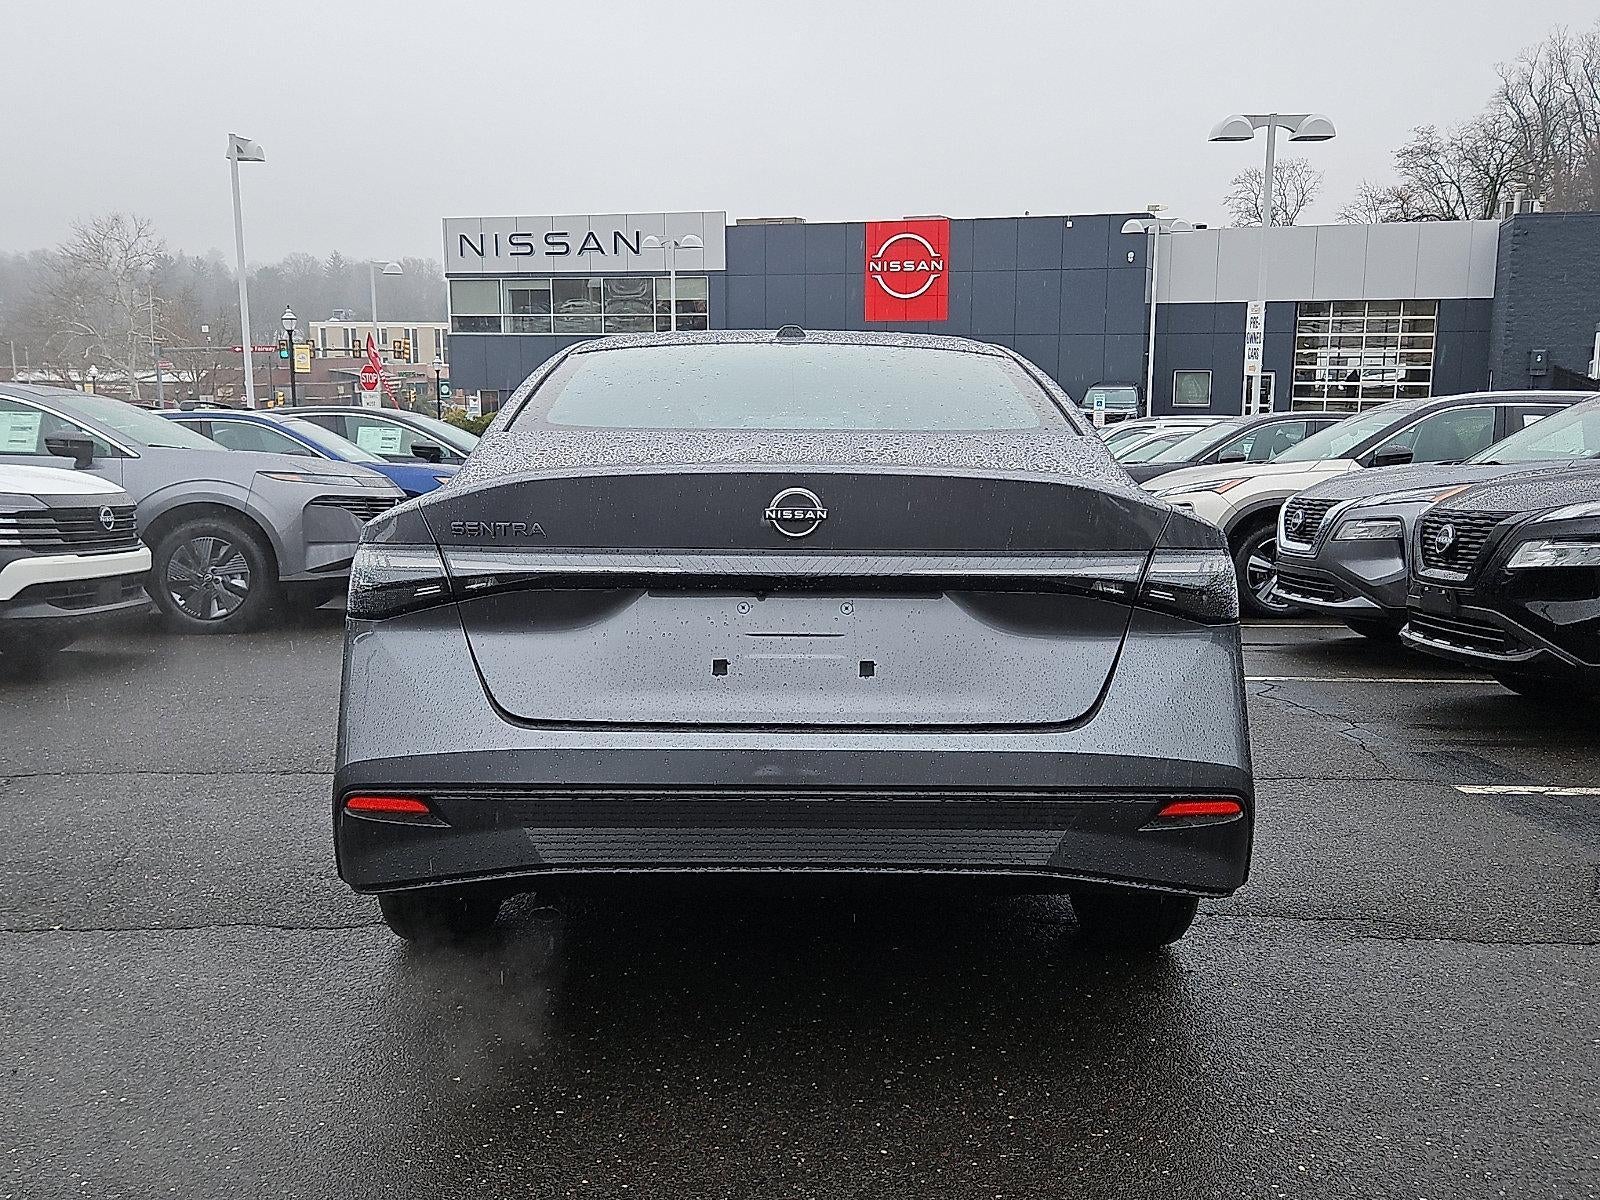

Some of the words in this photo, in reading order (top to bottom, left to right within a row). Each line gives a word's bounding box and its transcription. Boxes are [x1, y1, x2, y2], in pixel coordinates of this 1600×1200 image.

[458, 230, 642, 257] NISSAN
[869, 259, 944, 272] NISSAN
[1246, 331, 1262, 345] OWNED
[1247, 347, 1260, 360] CARS
[361, 373, 378, 383] STOP
[765, 510, 827, 519] NISSAN
[450, 520, 547, 538] SENTRA
